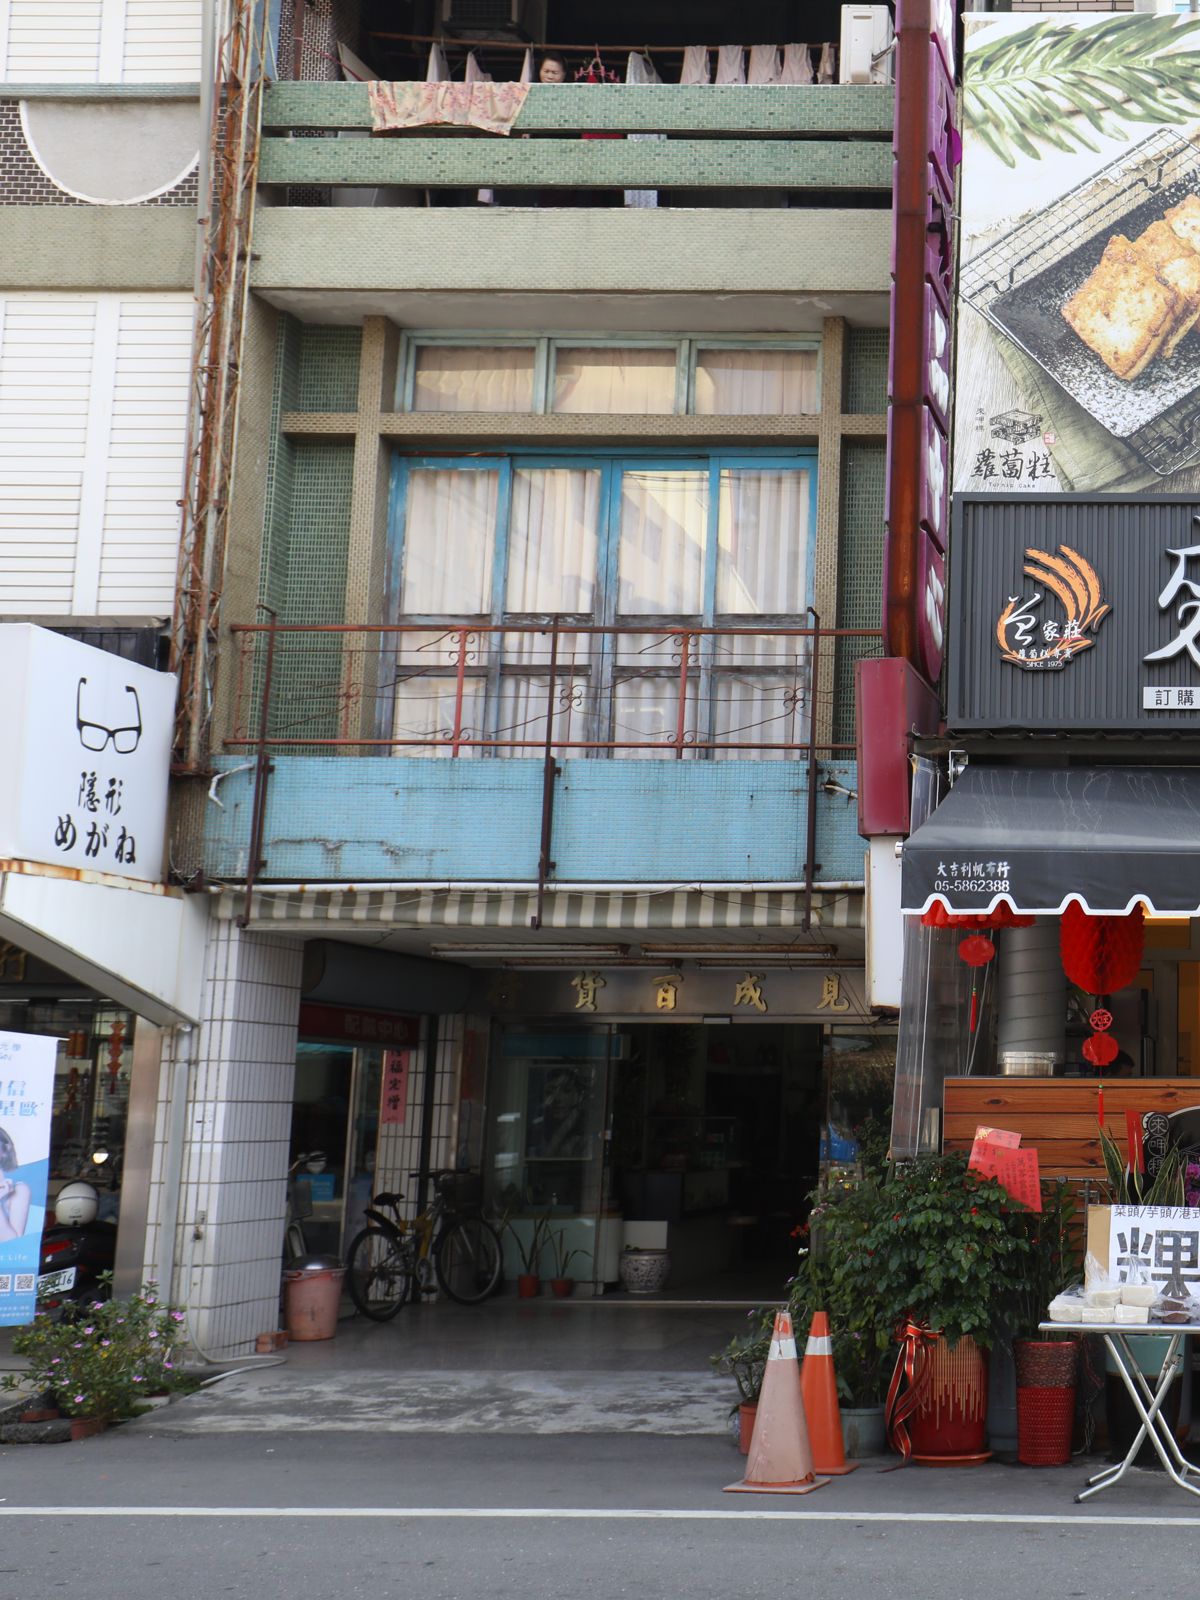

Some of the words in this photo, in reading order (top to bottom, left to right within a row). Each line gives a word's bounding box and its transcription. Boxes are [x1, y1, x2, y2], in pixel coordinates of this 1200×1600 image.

[55, 814, 135, 864] めがね
[934, 879, 1010, 892] 05-5862388
